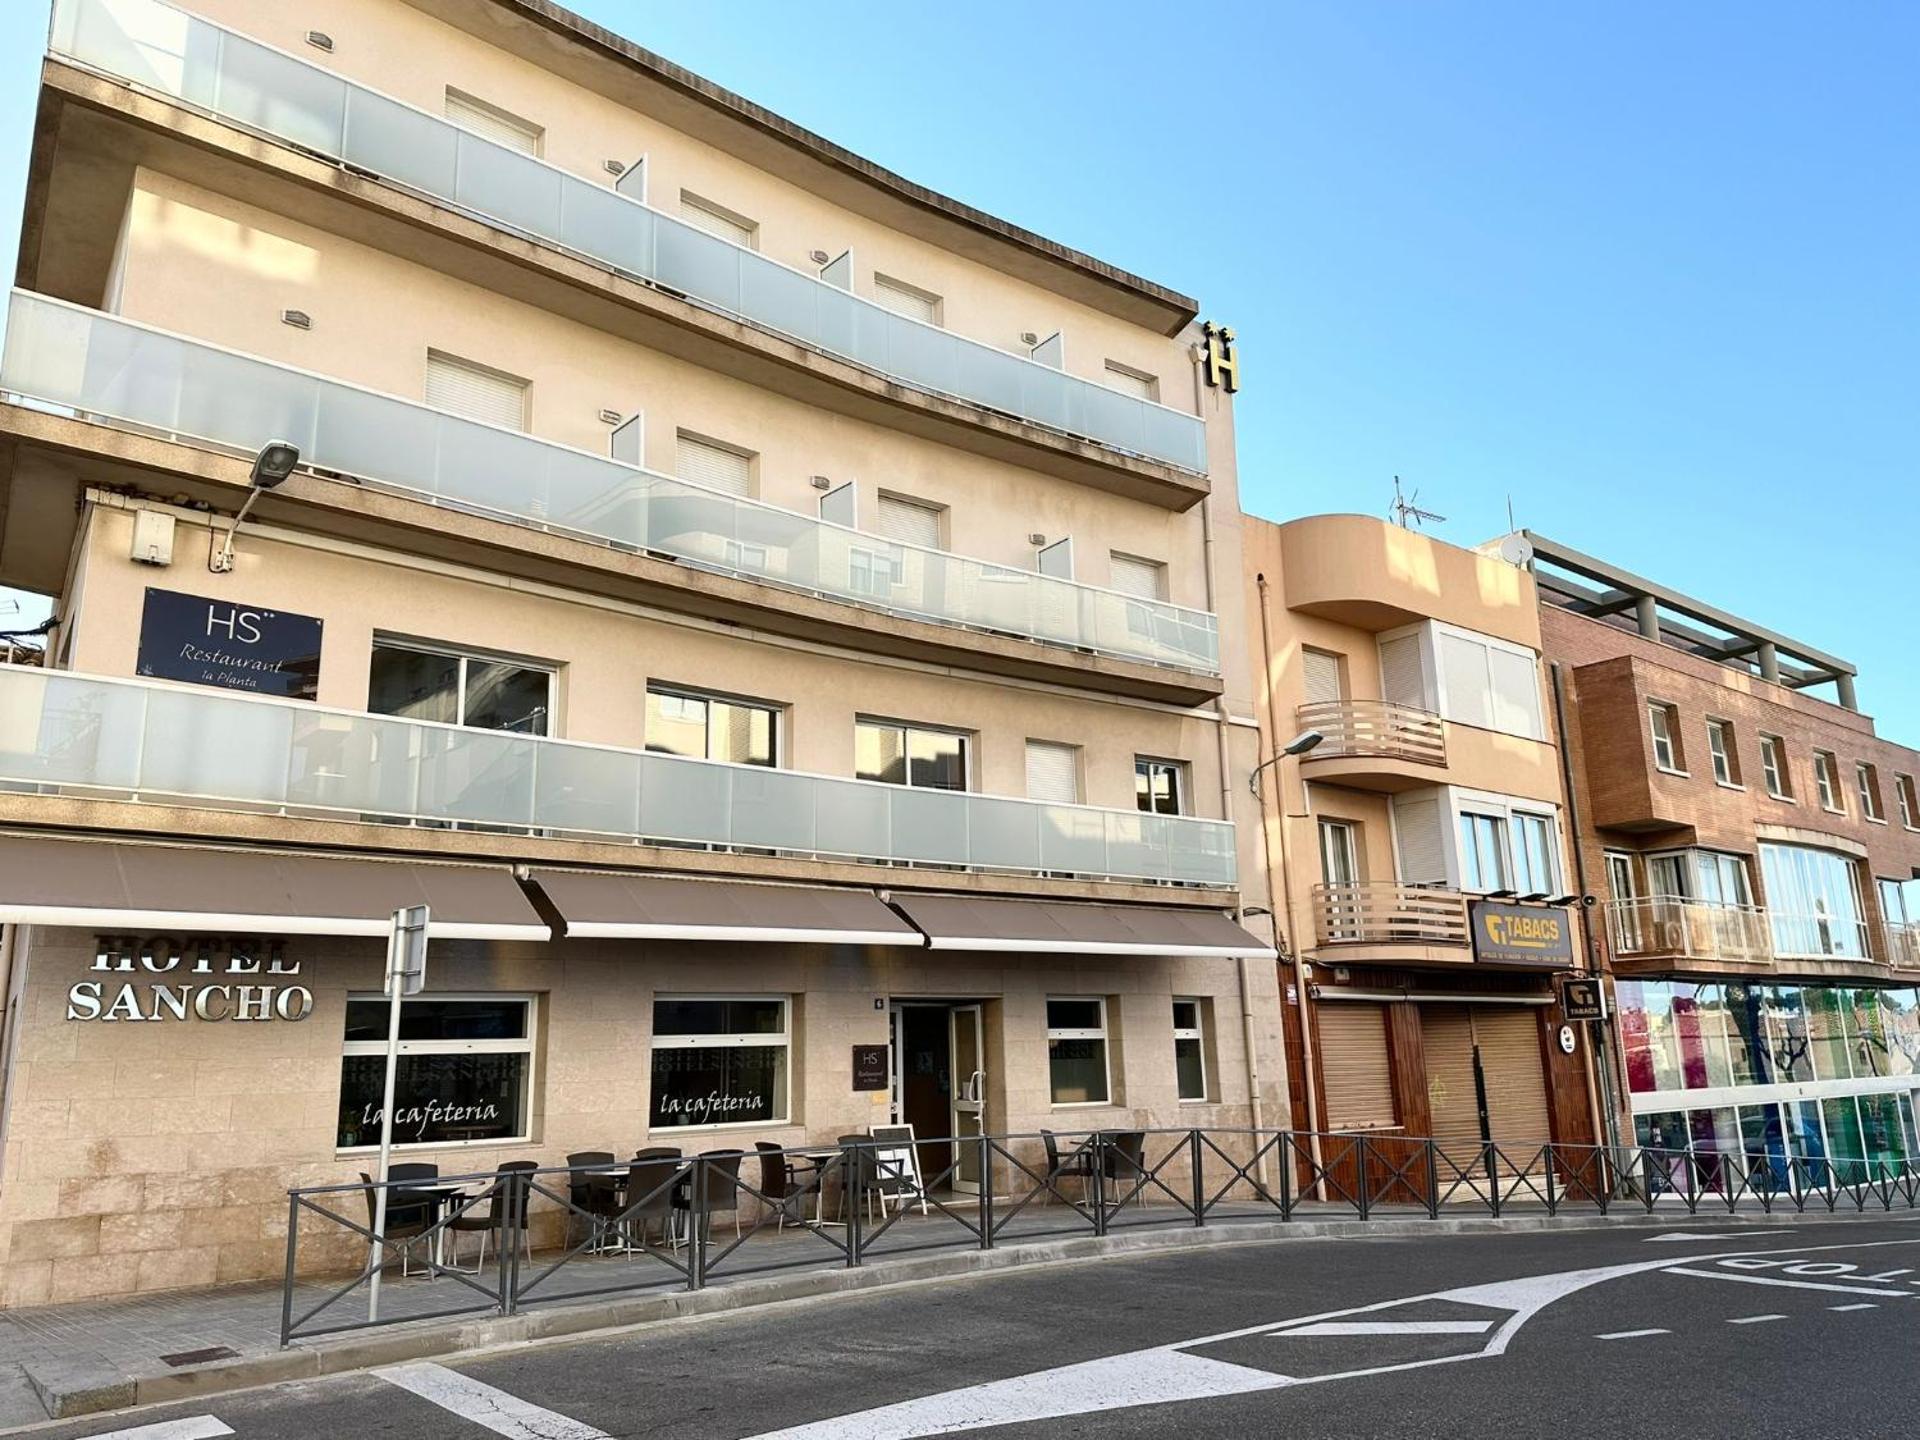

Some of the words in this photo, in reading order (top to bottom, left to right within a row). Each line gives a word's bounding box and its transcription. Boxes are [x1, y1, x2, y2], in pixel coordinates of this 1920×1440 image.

[179, 643, 284, 674] Restaurant
[202, 670, 213, 681] la
[216, 671, 258, 688] Planta
[1504, 915, 1560, 941] TABACS
[89, 933, 301, 975] HOTEL
[66, 982, 314, 1022] SANCHO
[362, 1102, 384, 1125] la
[395, 1098, 499, 1137] cafeteria
[660, 1093, 682, 1114] la
[685, 1090, 764, 1125] cafeteria
[1715, 1258, 1920, 1300] TOP
